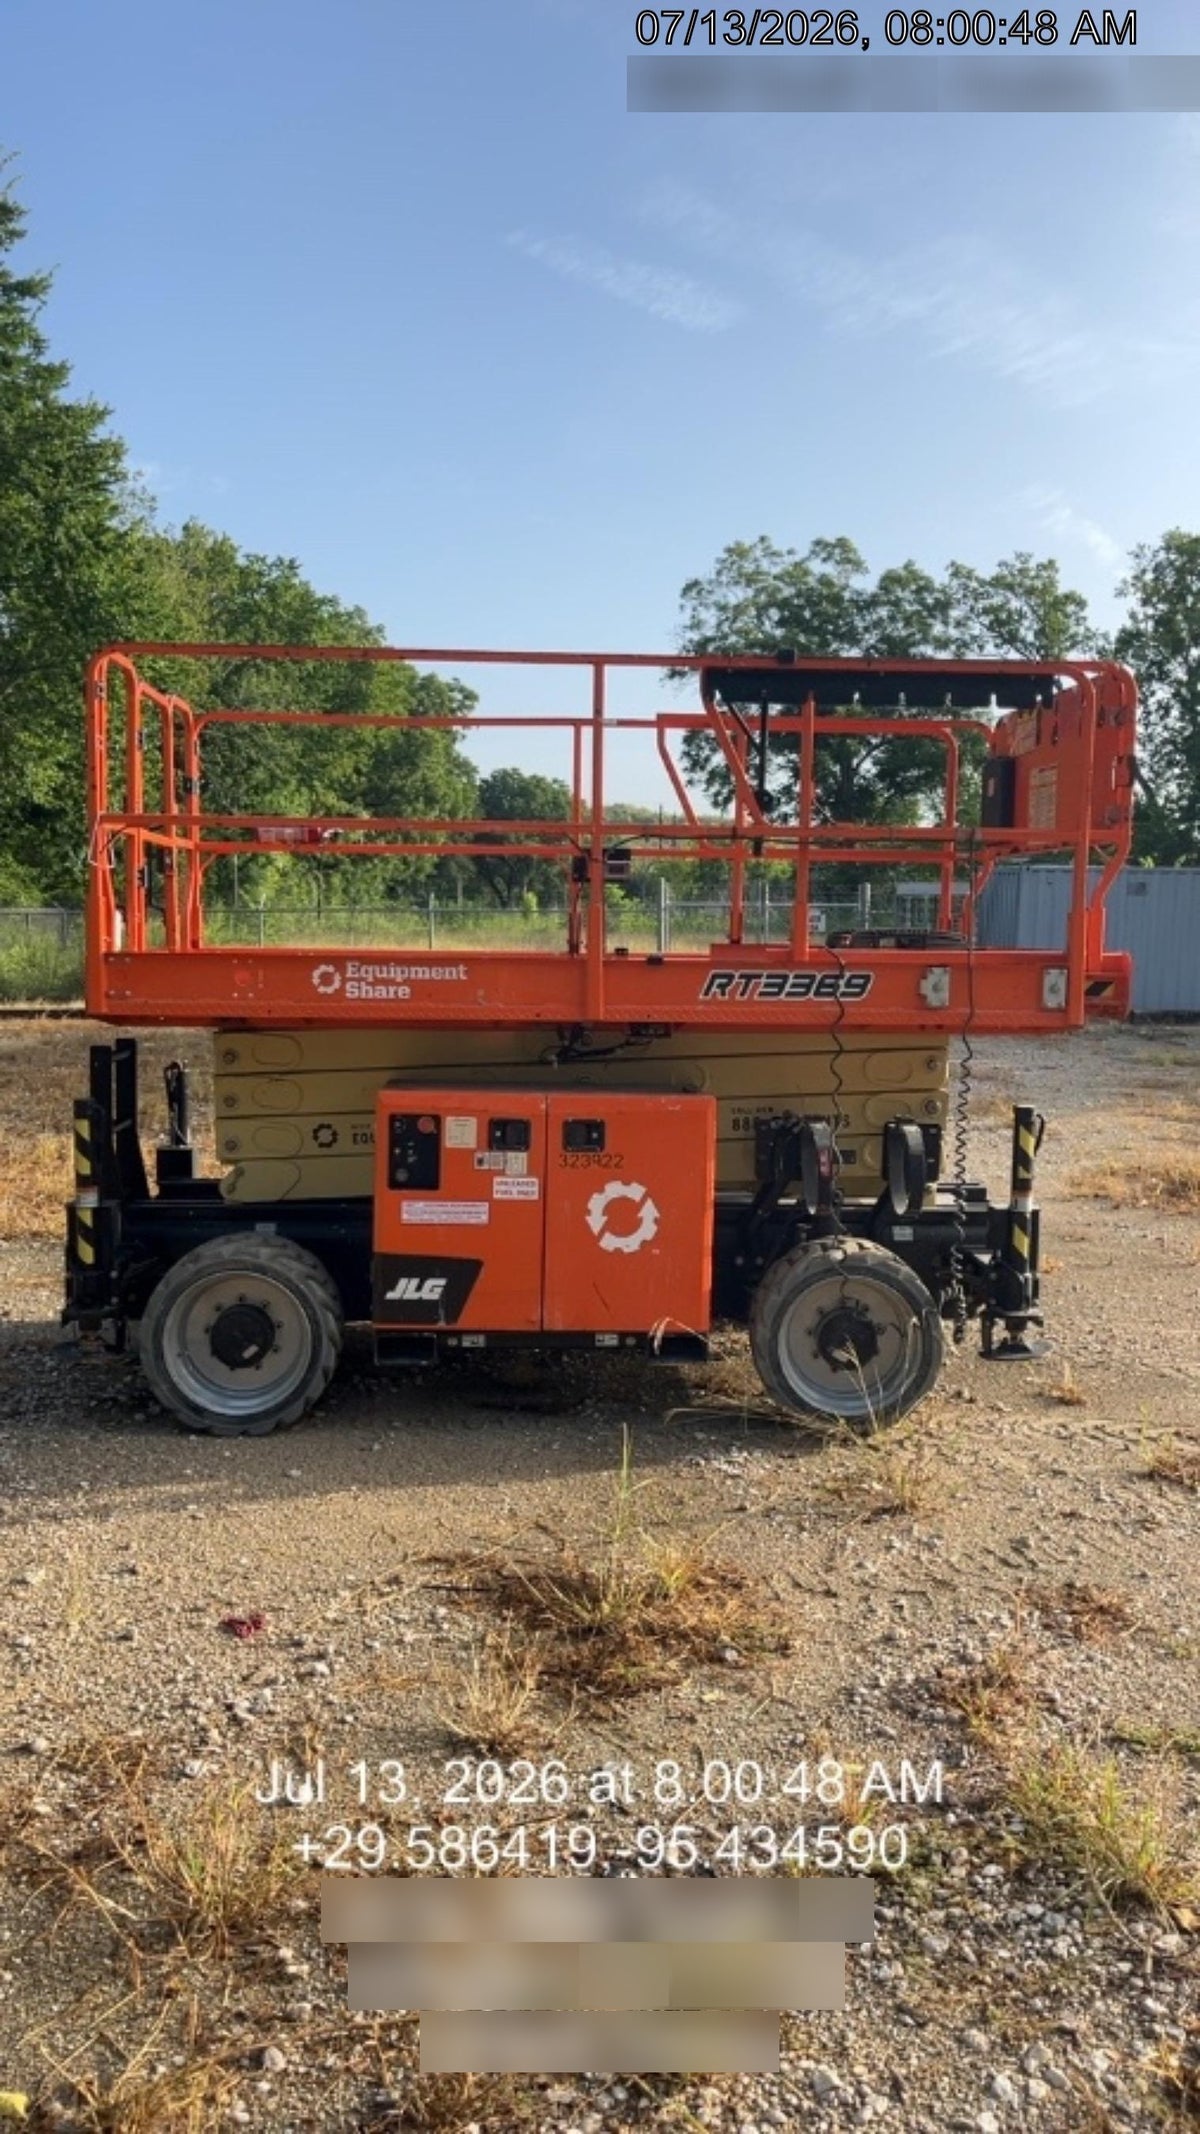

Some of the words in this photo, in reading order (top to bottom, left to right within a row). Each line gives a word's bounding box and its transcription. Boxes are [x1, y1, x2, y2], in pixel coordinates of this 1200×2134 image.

[345, 961, 468, 982] Equipment
[345, 981, 411, 999] Share
[700, 969, 875, 1001] RT3369
[385, 1277, 446, 1300] JLG
